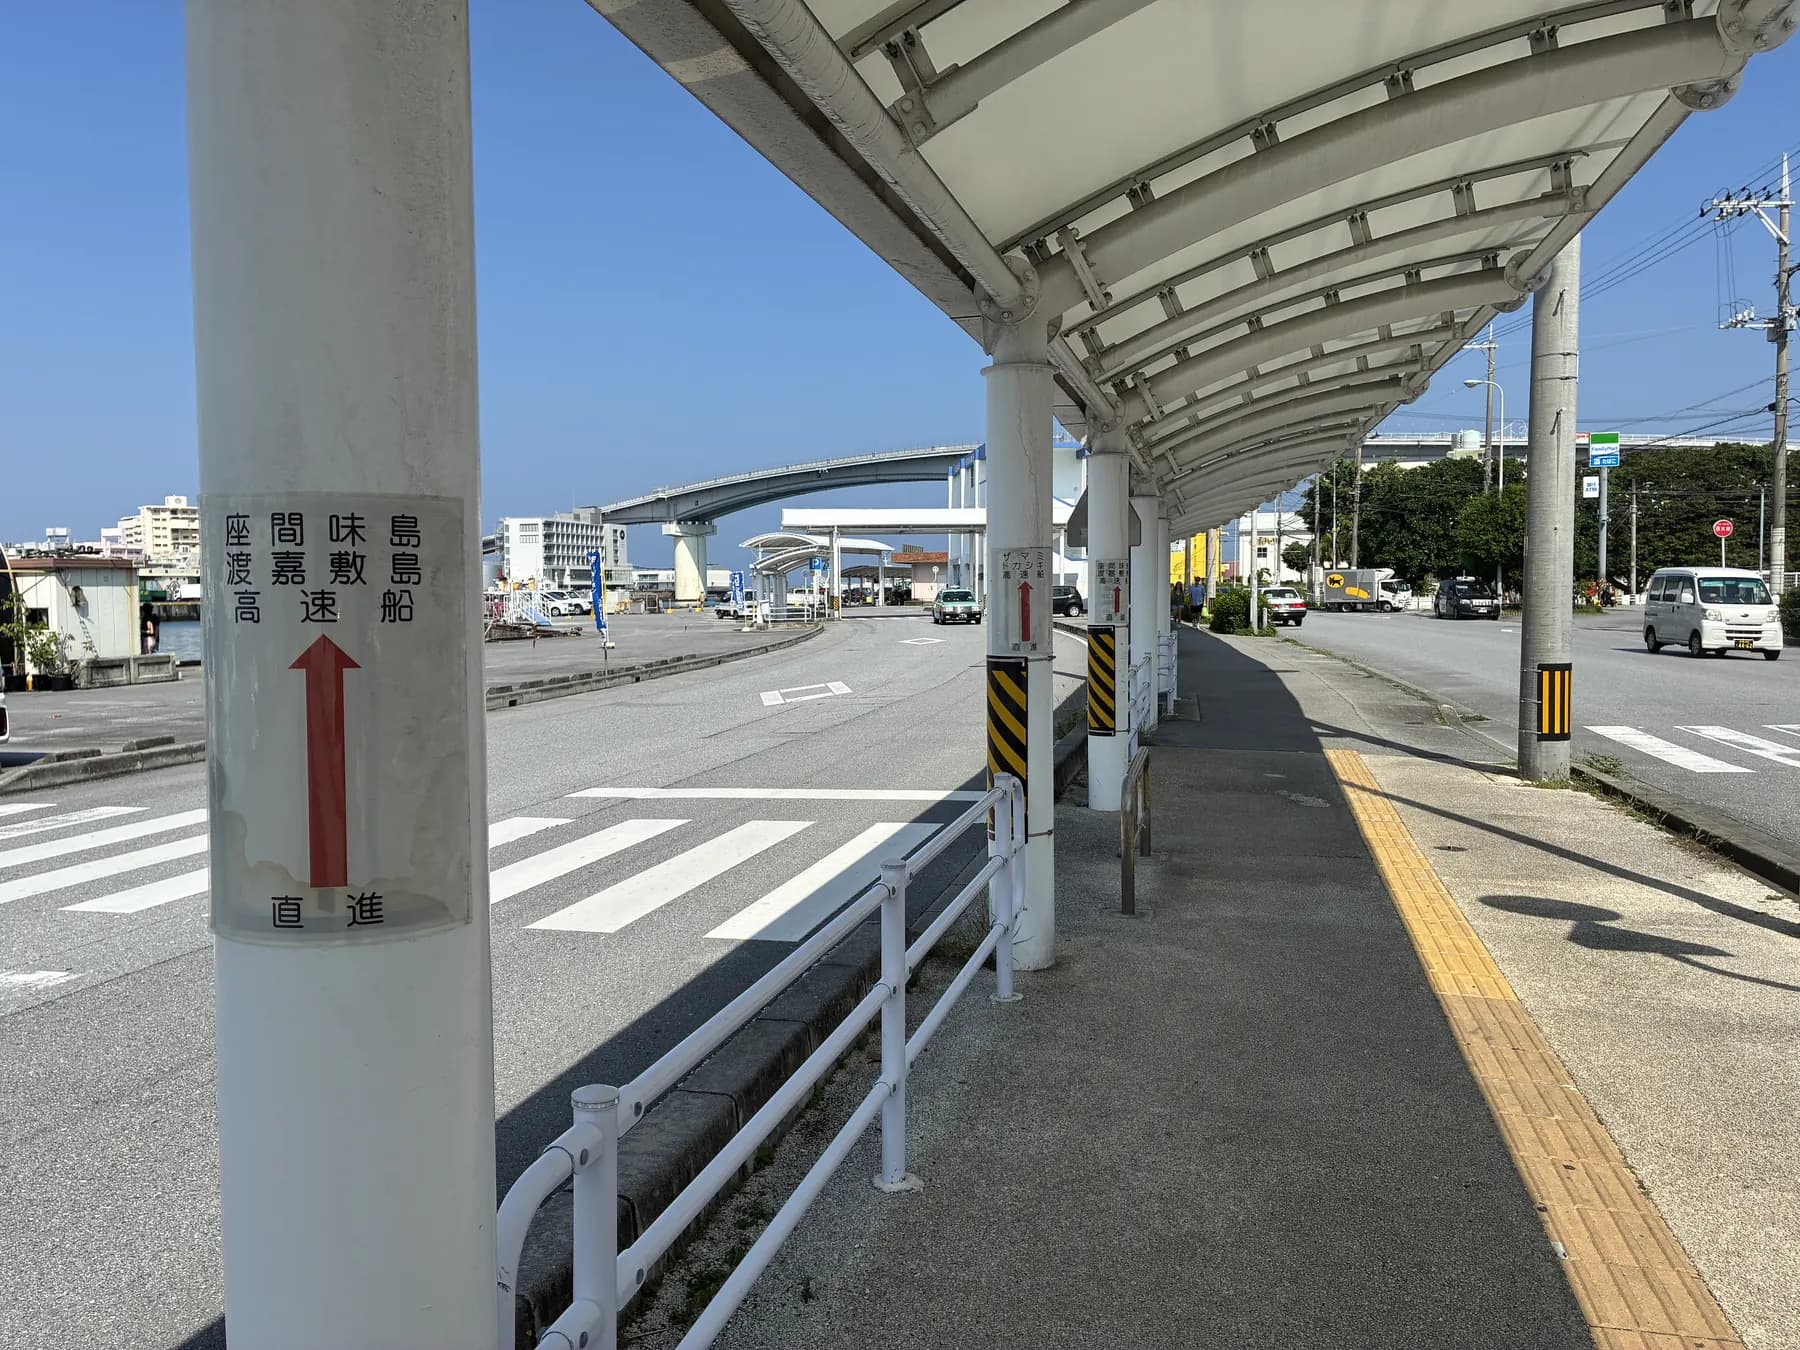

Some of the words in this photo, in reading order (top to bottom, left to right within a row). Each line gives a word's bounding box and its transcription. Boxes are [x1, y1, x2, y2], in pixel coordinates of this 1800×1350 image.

[225, 512, 421, 549] 座間味島
[226, 550, 422, 586] 渡嘉敷島
[1003, 552, 1044, 561] ザマミ
[234, 589, 414, 624] 高速船
[271, 892, 384, 930] 直進
